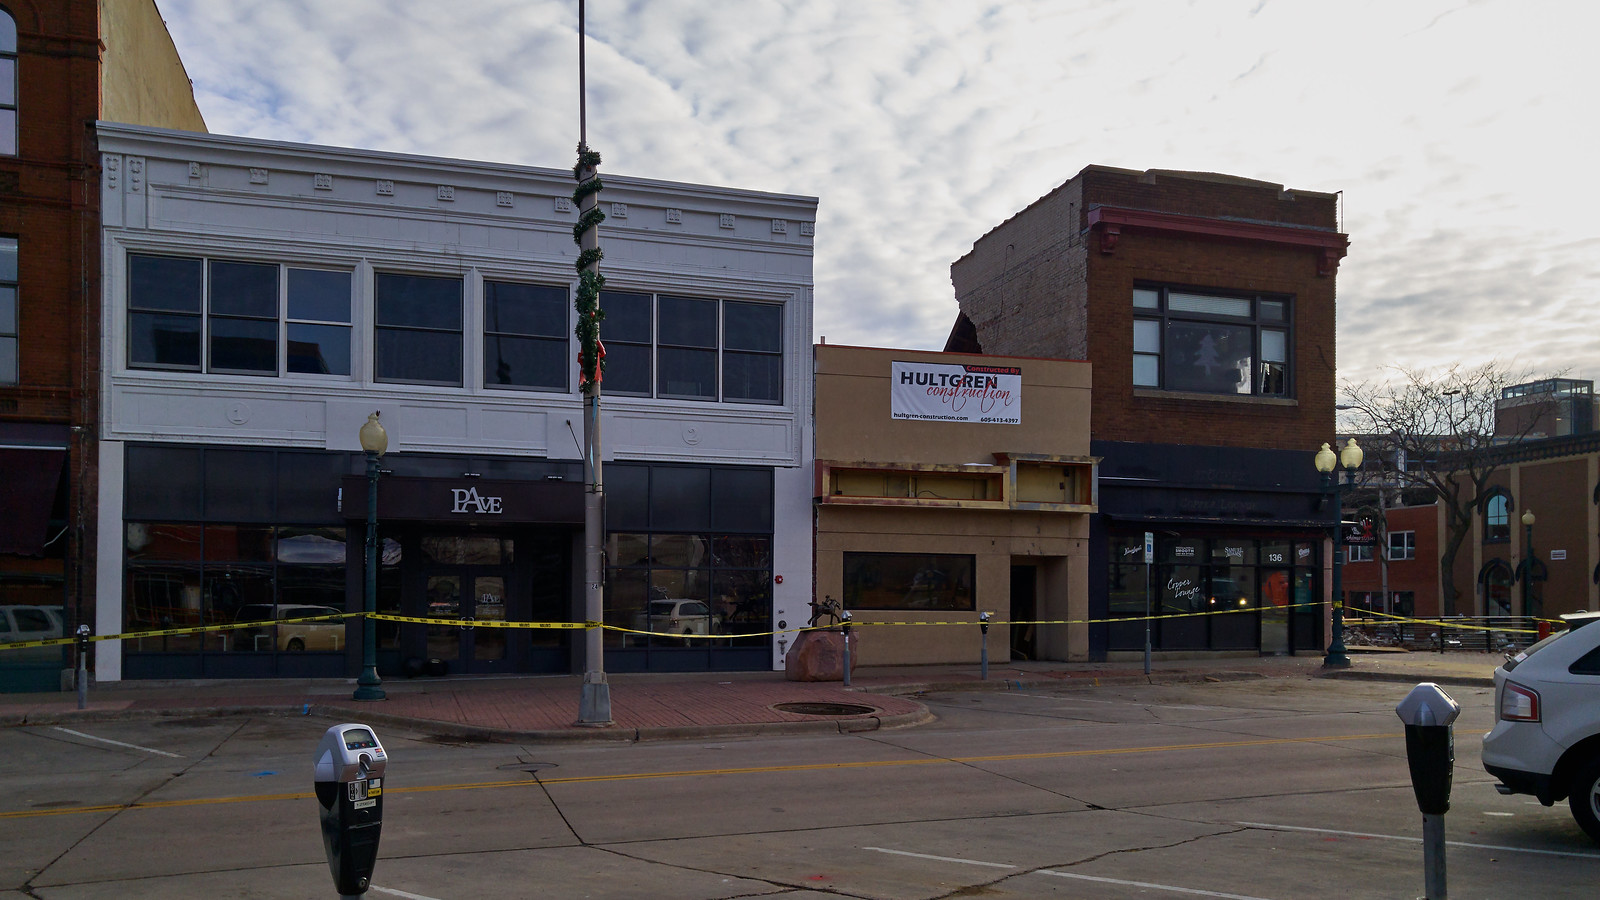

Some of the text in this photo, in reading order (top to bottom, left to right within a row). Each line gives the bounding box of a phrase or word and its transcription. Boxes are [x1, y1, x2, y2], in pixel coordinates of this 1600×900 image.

[966, 365, 1020, 375] Constructed By
[900, 371, 998, 389] HULTGREN
[926, 374, 1014, 413] construction
[893, 412, 969, 421] hultgren-construction.com
[1268, 553, 1283, 562] 136
[1167, 577, 1192, 591] Copper
[1174, 585, 1201, 600] Lounge
